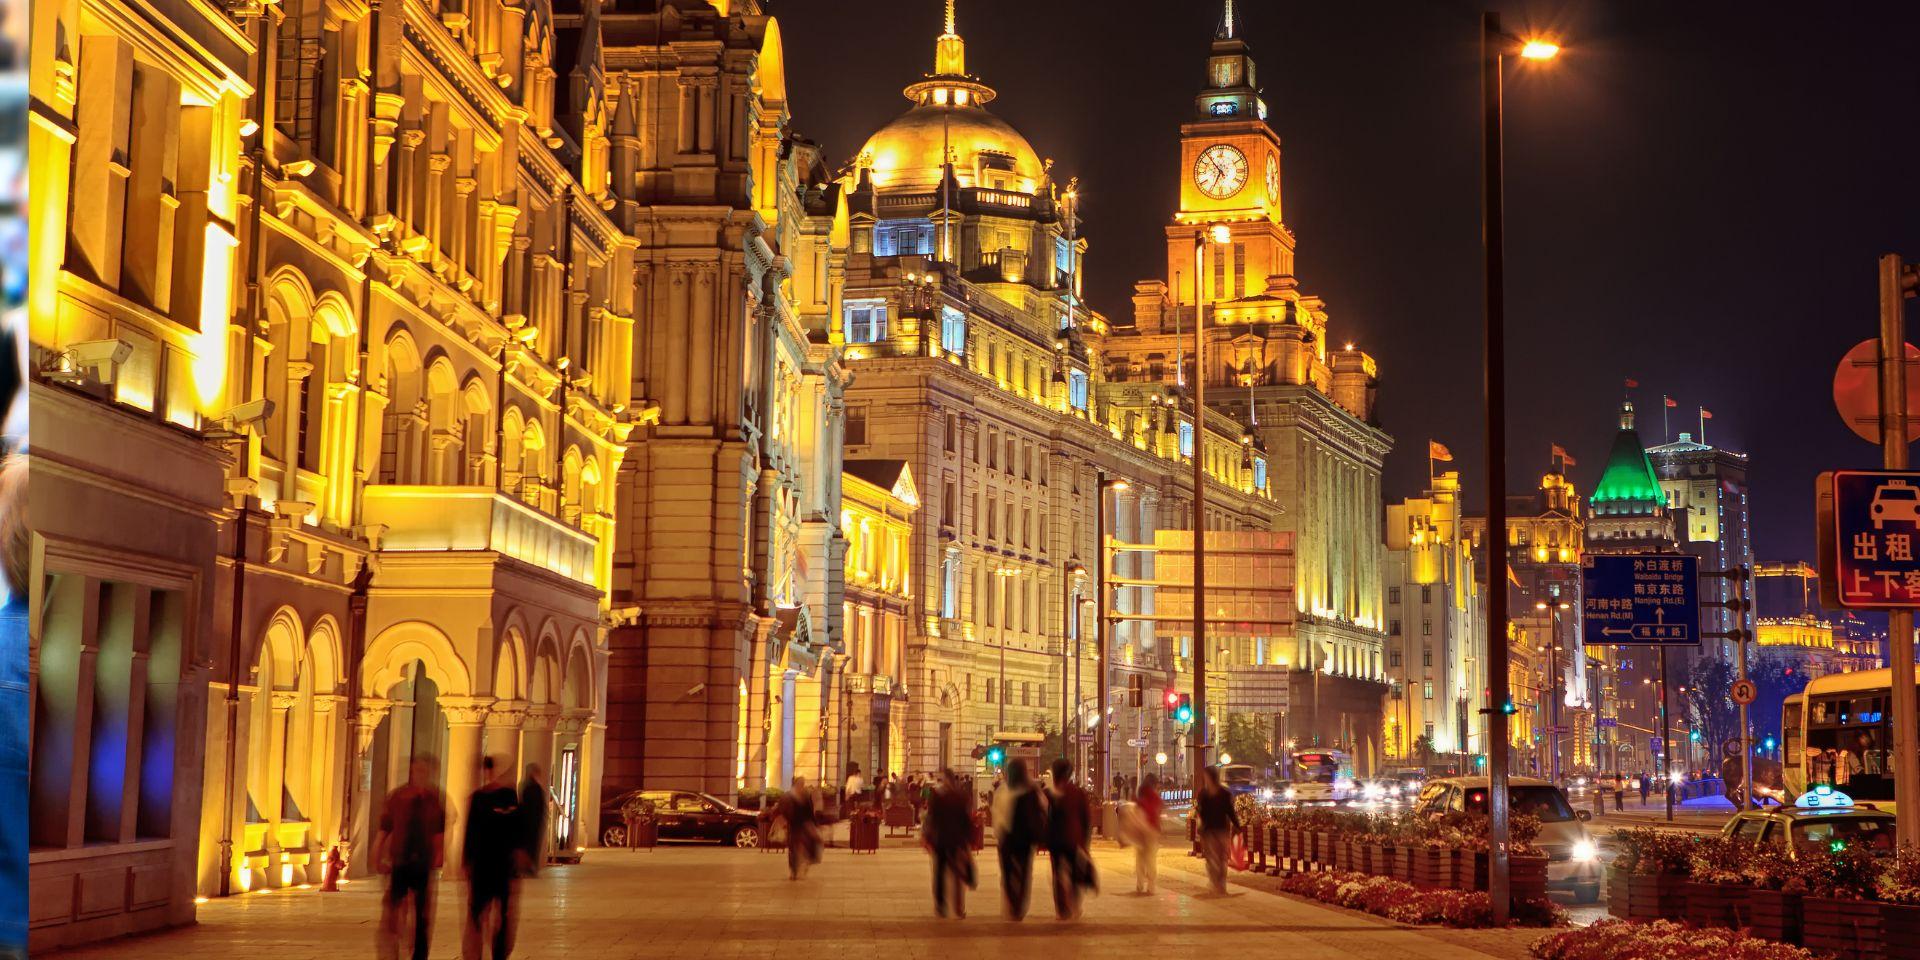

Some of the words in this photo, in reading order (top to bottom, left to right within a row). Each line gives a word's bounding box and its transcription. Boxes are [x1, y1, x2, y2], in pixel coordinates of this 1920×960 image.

[1853, 532, 1913, 561] 出租
[1634, 560, 1683, 571] 外白渡桥
[1634, 584, 1684, 595] 南京东路
[1585, 598, 1633, 610] 河南中路
[1635, 597, 1660, 605] Nanjing
[1642, 627, 1680, 636] 福州路
[1808, 796, 1846, 806] 巴士
